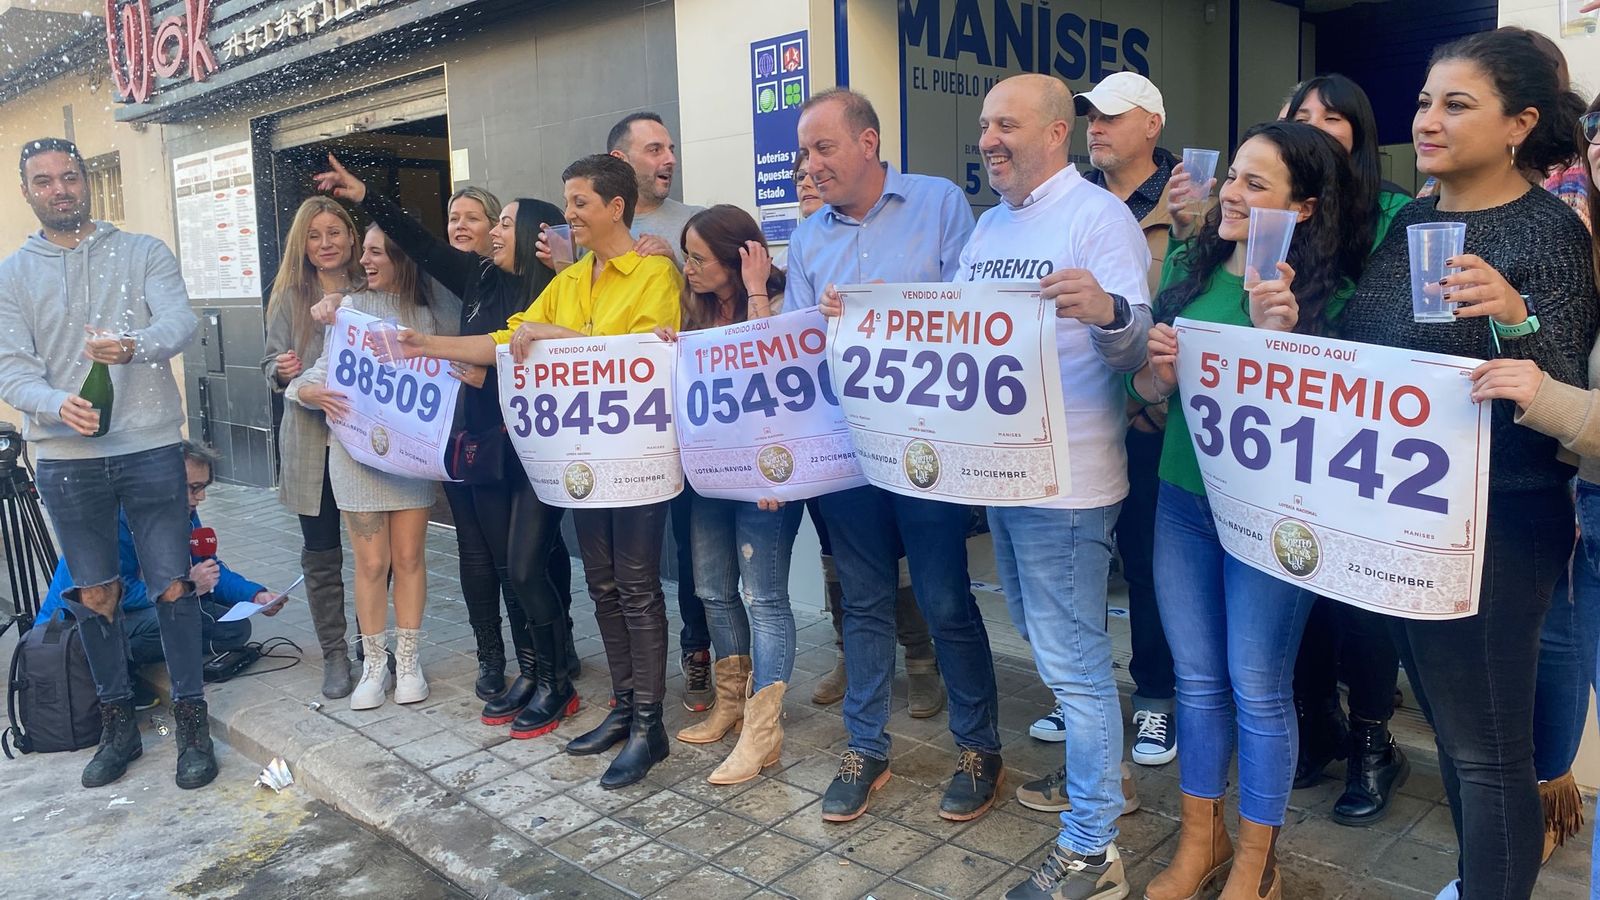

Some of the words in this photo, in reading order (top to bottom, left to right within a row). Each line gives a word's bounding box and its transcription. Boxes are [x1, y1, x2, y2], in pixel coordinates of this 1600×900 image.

[913, 66, 928, 91] EL
[933, 69, 979, 97] PUEBLO
[757, 152, 790, 165] Loterías
[791, 151, 797, 163] y
[758, 169, 793, 183] Apuestas
[758, 188, 785, 200] Estado
[982, 259, 1054, 280] PREMIO
[902, 291, 938, 299] VENDIDO
[940, 288, 962, 299] AQUÍ
[724, 324, 750, 336] VENDIDO
[751, 319, 770, 332] AQUÍ
[886, 310, 1014, 346] PREMIO
[549, 346, 584, 355] VENDIDO
[586, 343, 607, 352] AQUÍ
[710, 327, 826, 373] PREMIO
[1265, 339, 1320, 356] VENDIDO
[1323, 348, 1358, 362] AQUÍ
[534, 357, 655, 389] PREMIO
[842, 345, 1028, 416] 25296
[335, 348, 442, 423] 88509
[1236, 358, 1431, 428] PREMIO
[509, 387, 672, 438] 38454
[820, 451, 857, 462] DICIEMBRE
[872, 453, 898, 465] NAVIDAD
[1190, 394, 1450, 515] 36142
[625, 473, 665, 483] DICIEMBRE
[694, 465, 719, 475] LOTERÍA
[973, 469, 1027, 478] DICIEMBRE
[1228, 521, 1263, 541] NAVIDAD
[1404, 529, 1435, 540] MANISES
[1348, 562, 1361, 573] 22
[1365, 567, 1434, 588] DICIEMBRE
